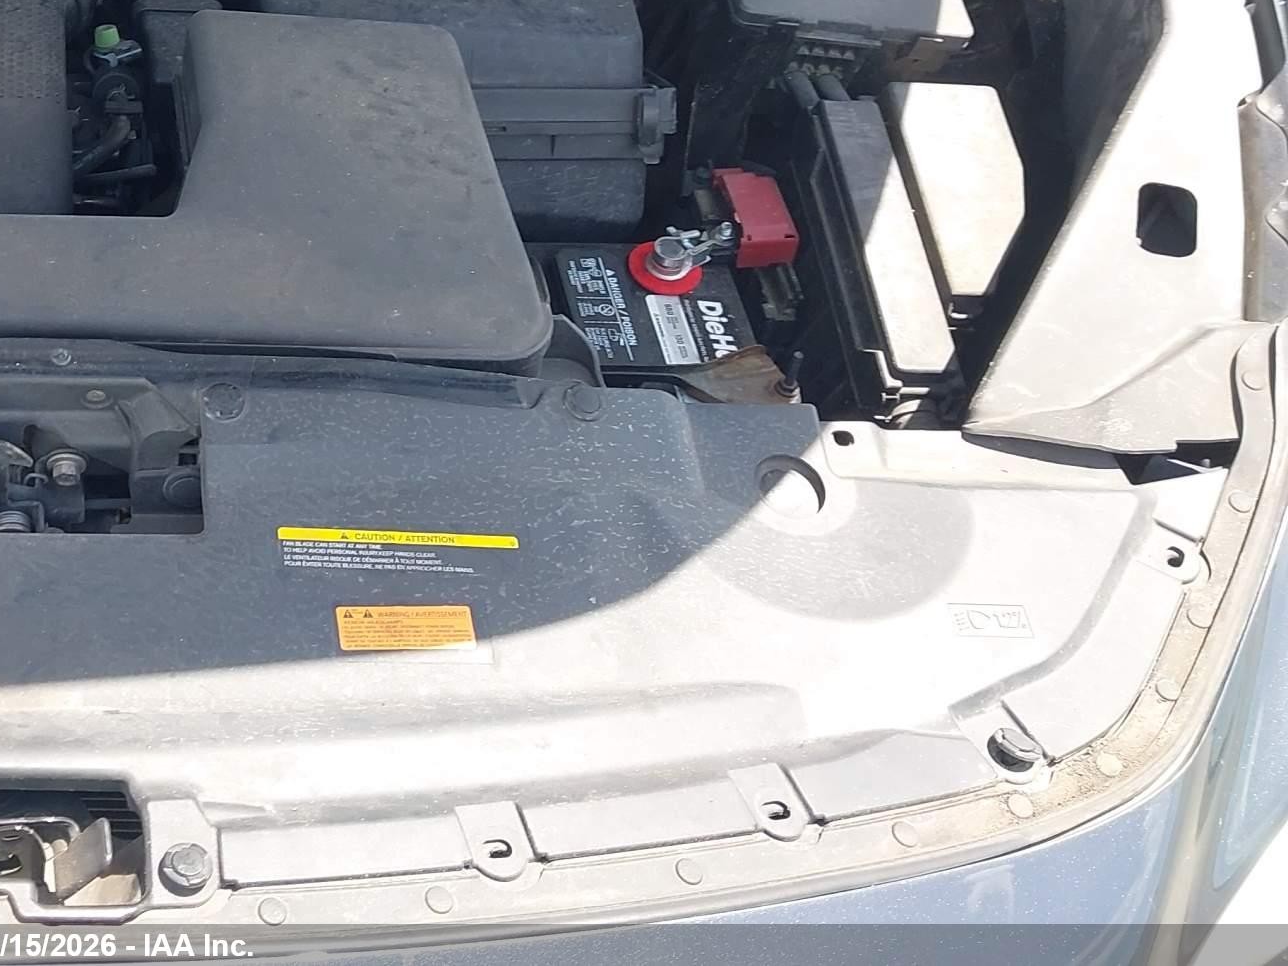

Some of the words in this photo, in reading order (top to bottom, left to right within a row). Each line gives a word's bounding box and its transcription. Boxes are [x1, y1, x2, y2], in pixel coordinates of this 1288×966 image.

[608, 277, 626, 308] DANGER
[621, 316, 638, 346] POISON
[355, 533, 395, 541] CAUTION
[405, 535, 455, 543] ATTENTION
